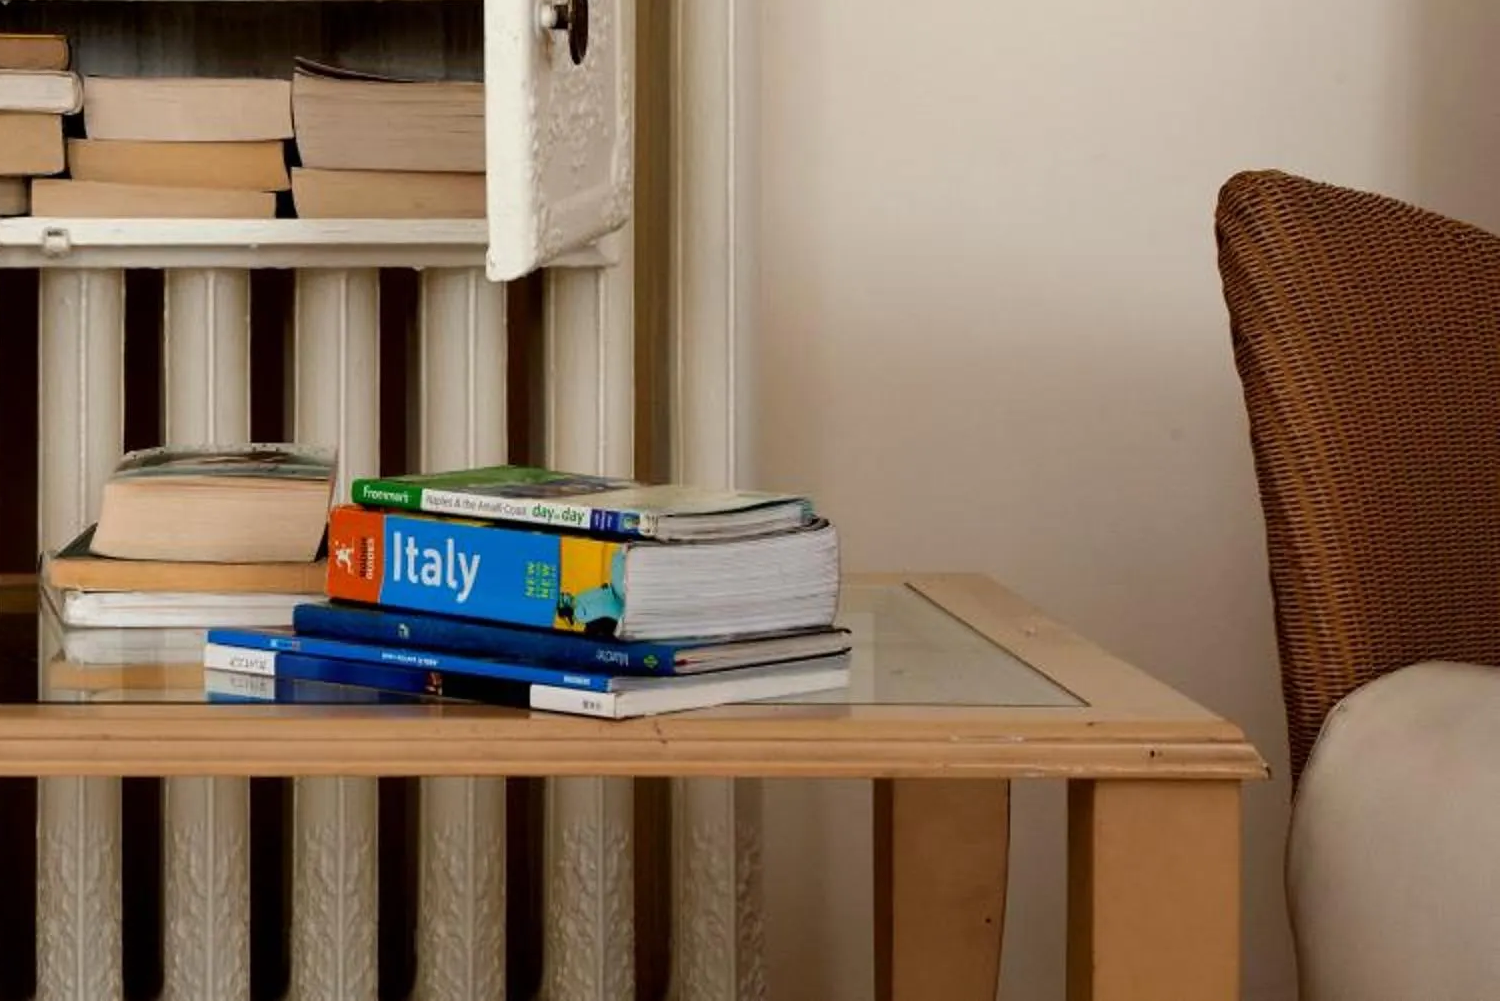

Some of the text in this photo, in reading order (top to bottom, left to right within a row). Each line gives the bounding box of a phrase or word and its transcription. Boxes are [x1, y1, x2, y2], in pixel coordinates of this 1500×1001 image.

[425, 493, 454, 509] Naples
[462, 498, 477, 510] the
[531, 503, 554, 523] day
[561, 507, 585, 526] day
[392, 531, 481, 604] Italy
